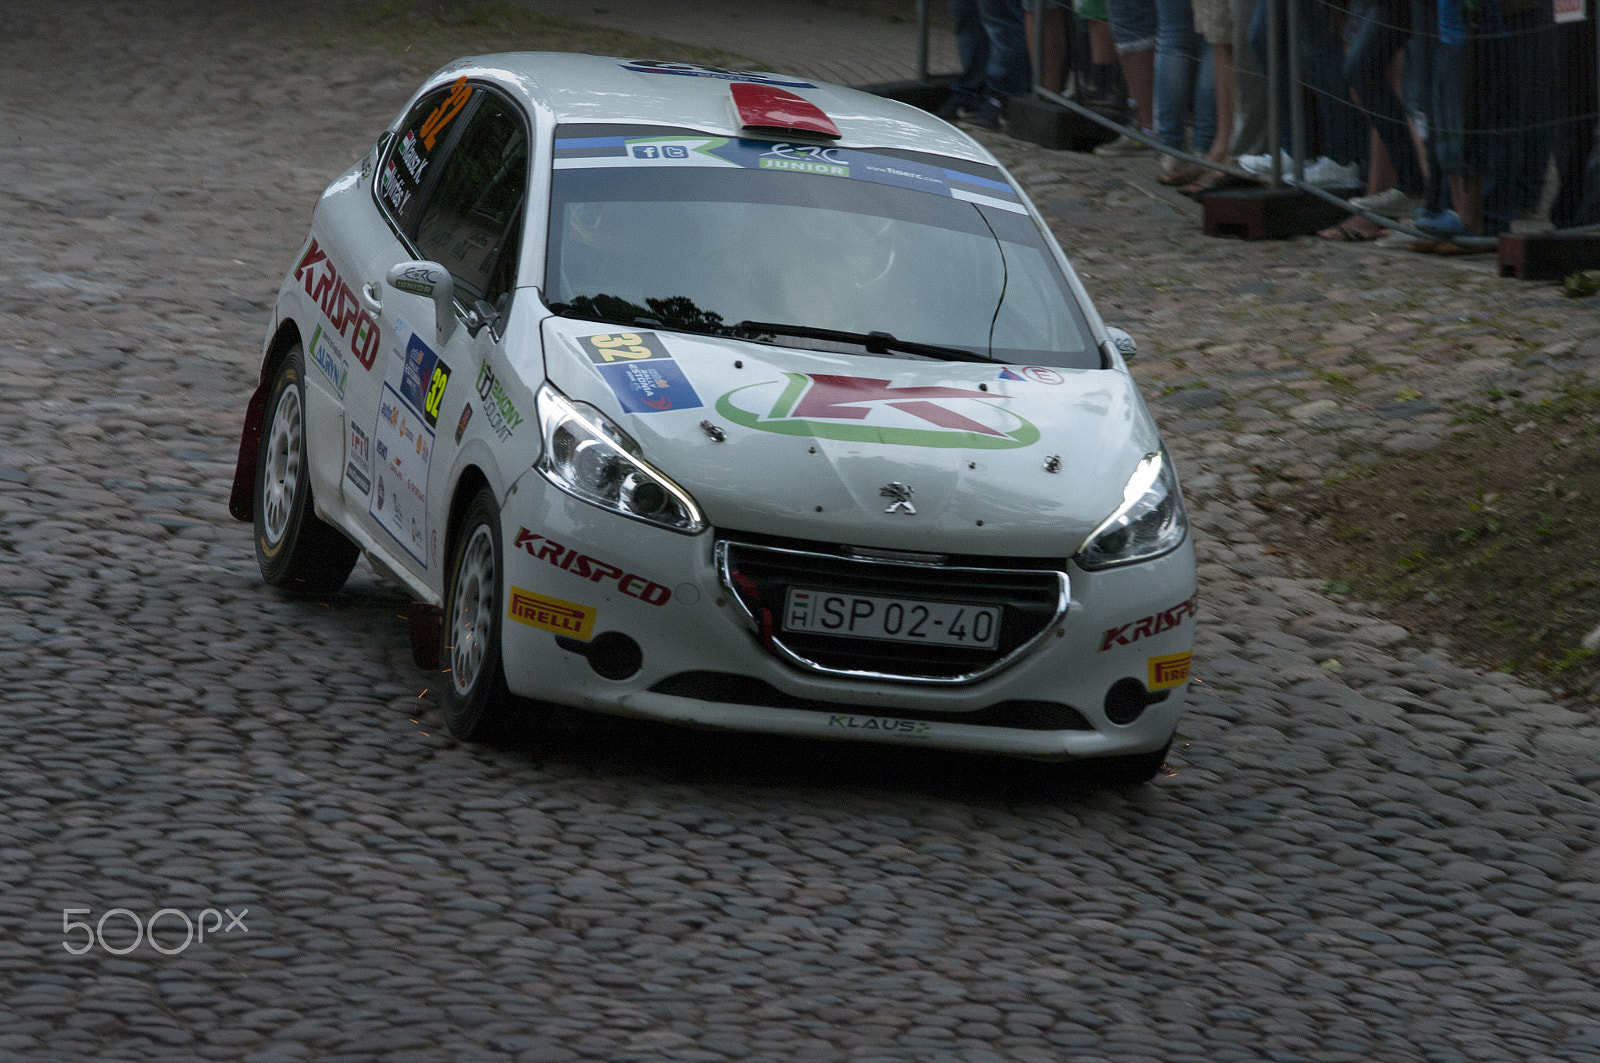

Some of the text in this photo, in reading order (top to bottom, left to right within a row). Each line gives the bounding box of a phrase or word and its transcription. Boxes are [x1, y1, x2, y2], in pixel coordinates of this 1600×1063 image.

[420, 76, 472, 151] 32
[765, 159, 844, 175] JUNIOR
[294, 237, 381, 371] KRISPED
[590, 333, 652, 362] 32
[425, 368, 447, 418] 32
[628, 363, 654, 396] ESTONIA
[491, 378, 524, 430] BAKONY
[514, 526, 672, 606] KRISPED
[512, 593, 585, 632] PIRELLI
[791, 611, 807, 627] H
